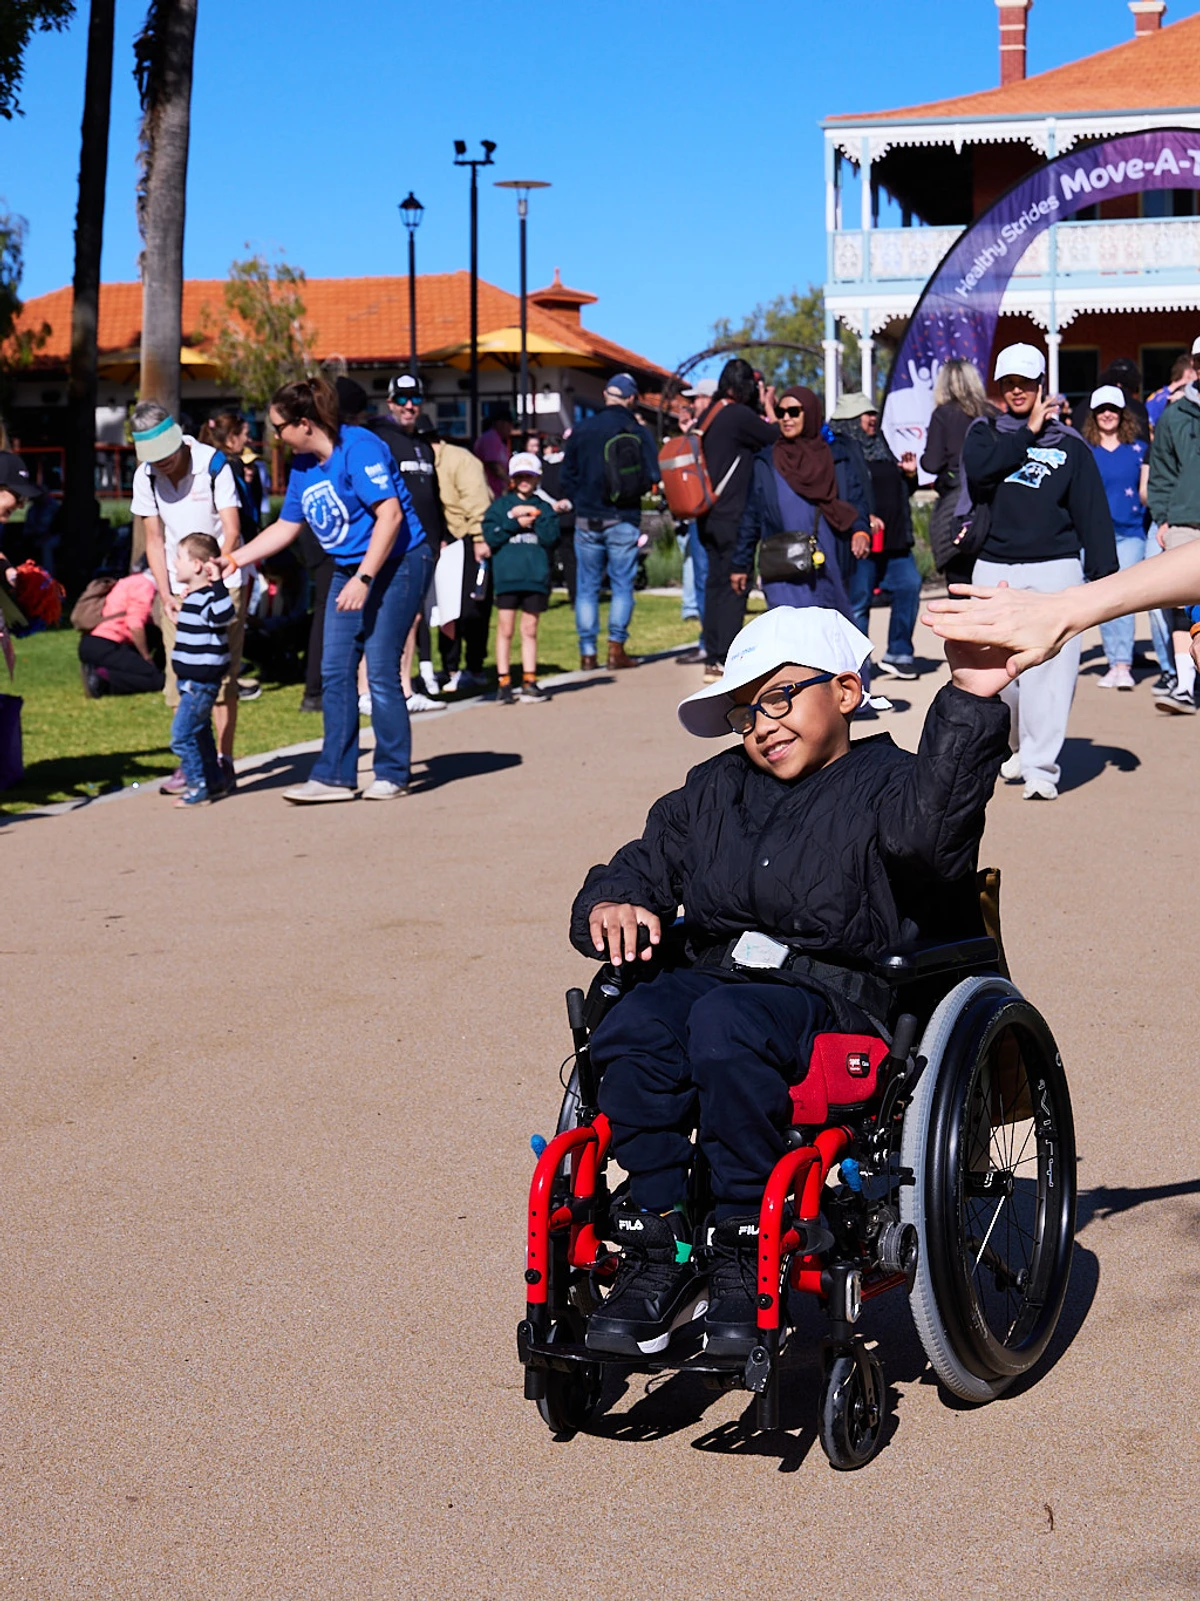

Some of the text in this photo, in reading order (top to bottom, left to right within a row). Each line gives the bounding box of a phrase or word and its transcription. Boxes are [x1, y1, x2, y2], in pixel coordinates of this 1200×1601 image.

[955, 238, 1008, 299] Healthy
[1001, 195, 1060, 244] Strides
[618, 1218, 644, 1231] FILA
